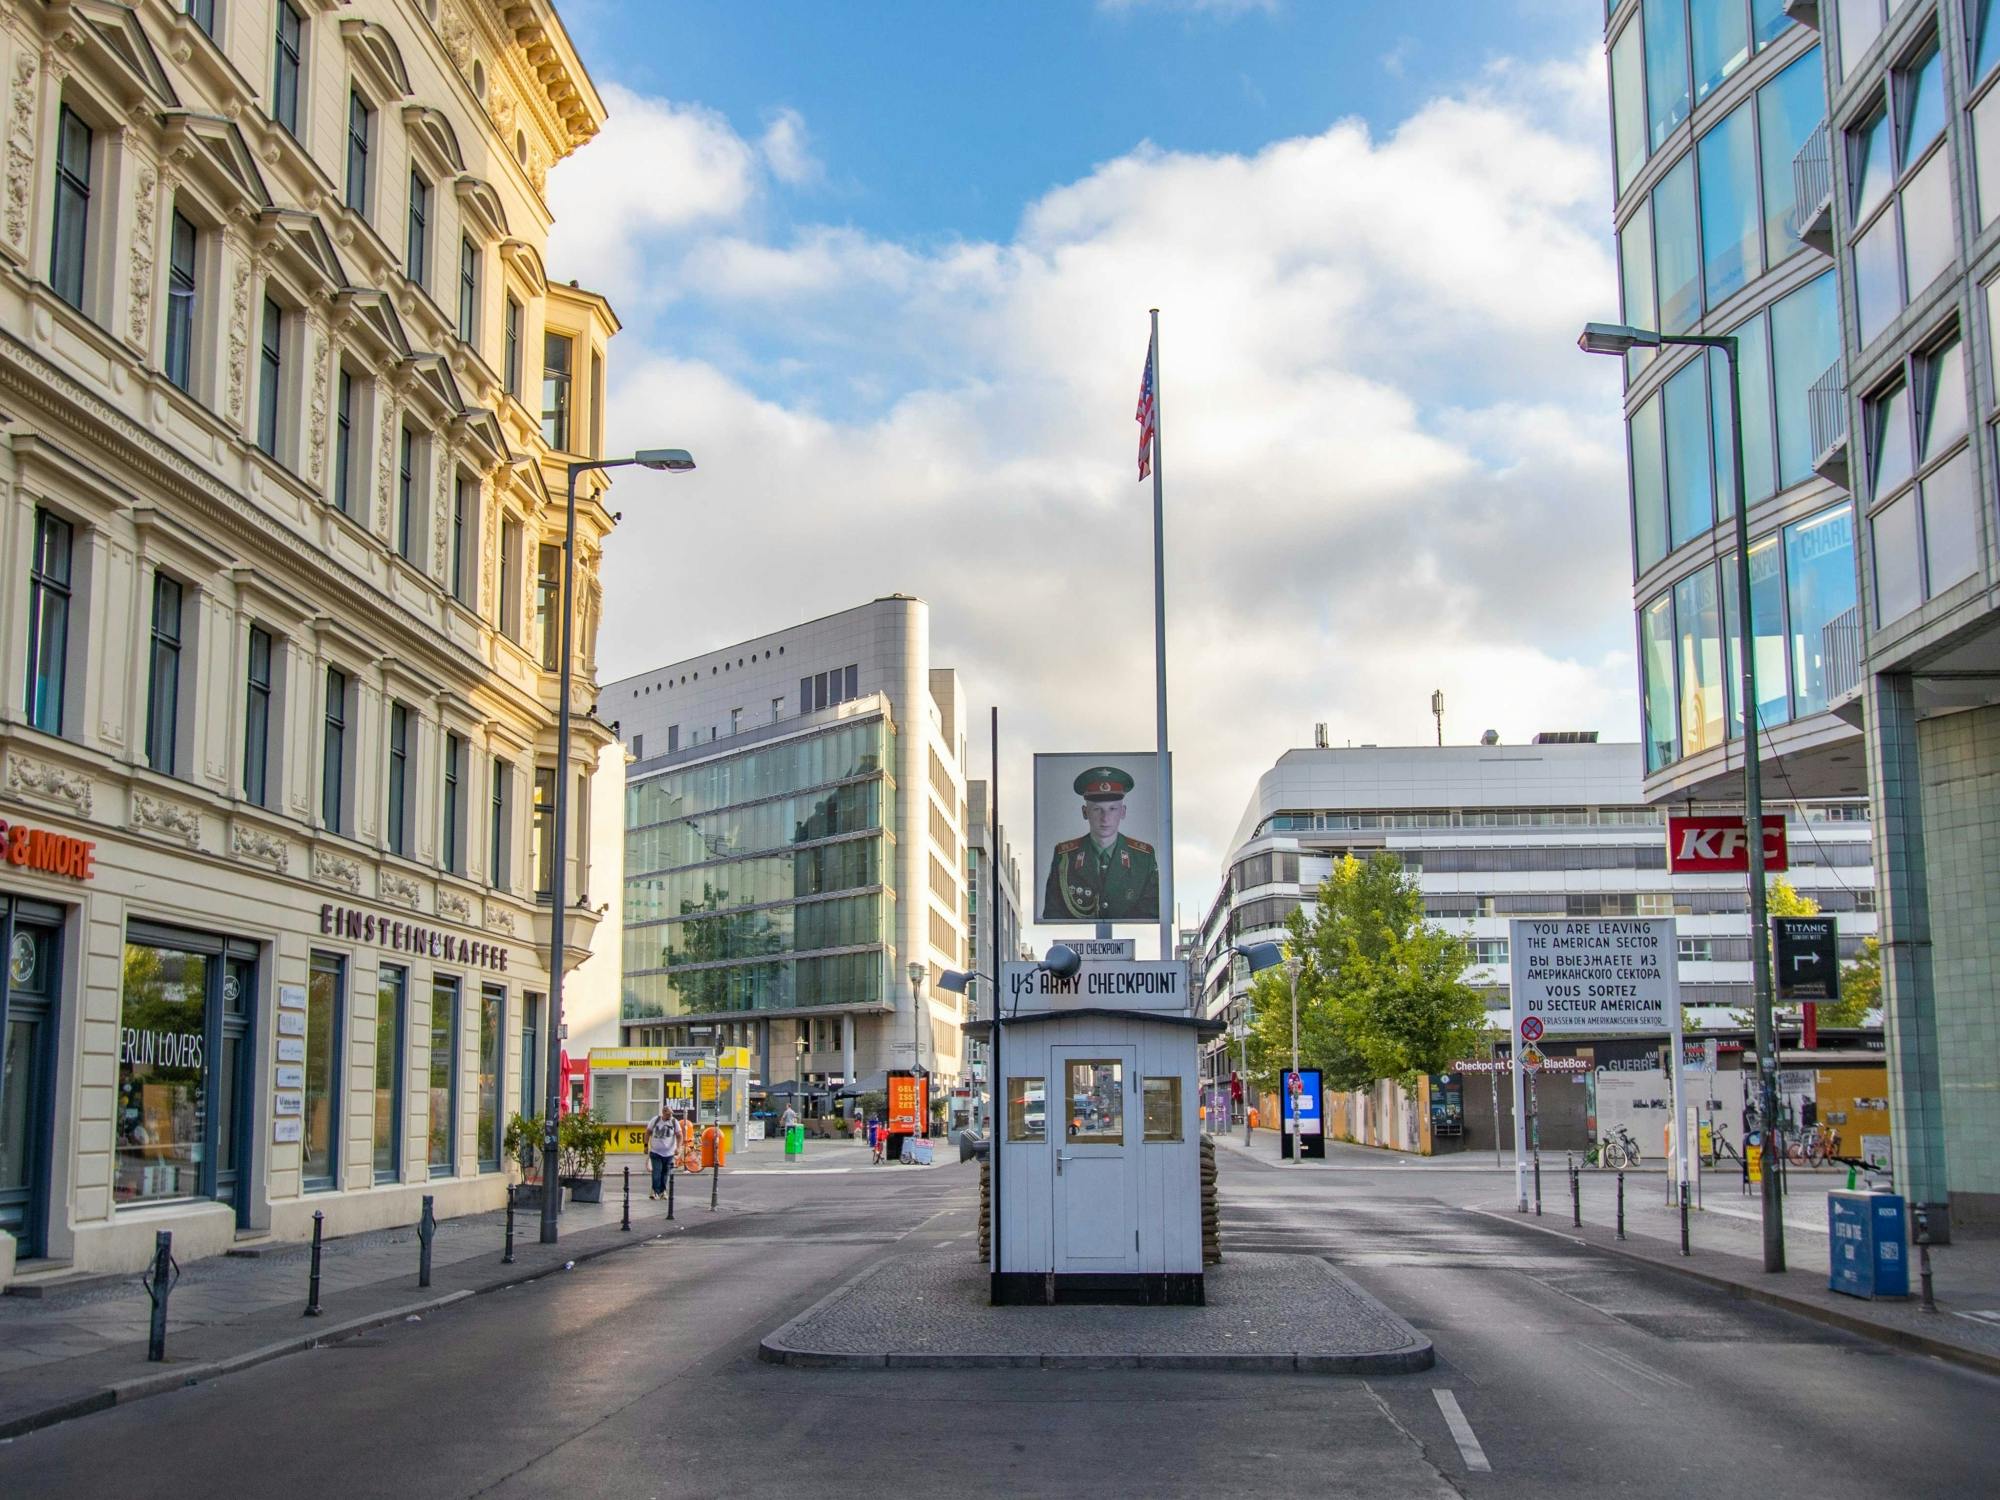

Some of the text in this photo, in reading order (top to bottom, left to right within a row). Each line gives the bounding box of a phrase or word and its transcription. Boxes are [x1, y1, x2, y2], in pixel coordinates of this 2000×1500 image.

[1676, 826, 1783, 860] KFC
[8, 825, 31, 865] &
[29, 829, 96, 880] MORE
[1533, 922, 1651, 935] YOU ARE LEAVING
[1785, 923, 1828, 932] TITANIC
[321, 903, 508, 972] EINSTEIN KAFFEE
[1527, 936, 1658, 949] THE AMERICAN SECTOR
[1086, 942, 1125, 955] CHECKPOINT
[1530, 955, 1657, 967] ВЫ ВЫЕЗЖАЕТЕ ИЗ
[1527, 968, 1661, 980] АМЕРИКАНСКОГО СЕКТОРА
[1039, 973, 1082, 995] ARMY
[1088, 971, 1178, 994] CHECKPOINT
[1546, 985, 1637, 997] VOUS SORTEZ
[1528, 1000, 1543, 1011] DU
[1547, 999, 1596, 1011] SECTEUR
[1573, 1016, 1586, 1025] DEN
[1587, 1016, 1638, 1025] AMERIKANISCHEN
[1639, 1016, 1662, 1025] SEKTOR
[158, 1031, 203, 1069] LOVERS
[1455, 1060, 1505, 1071] Checkpont
[1543, 1058, 1587, 1069] BlackBox
[1609, 1059, 1656, 1071] GUERRE
